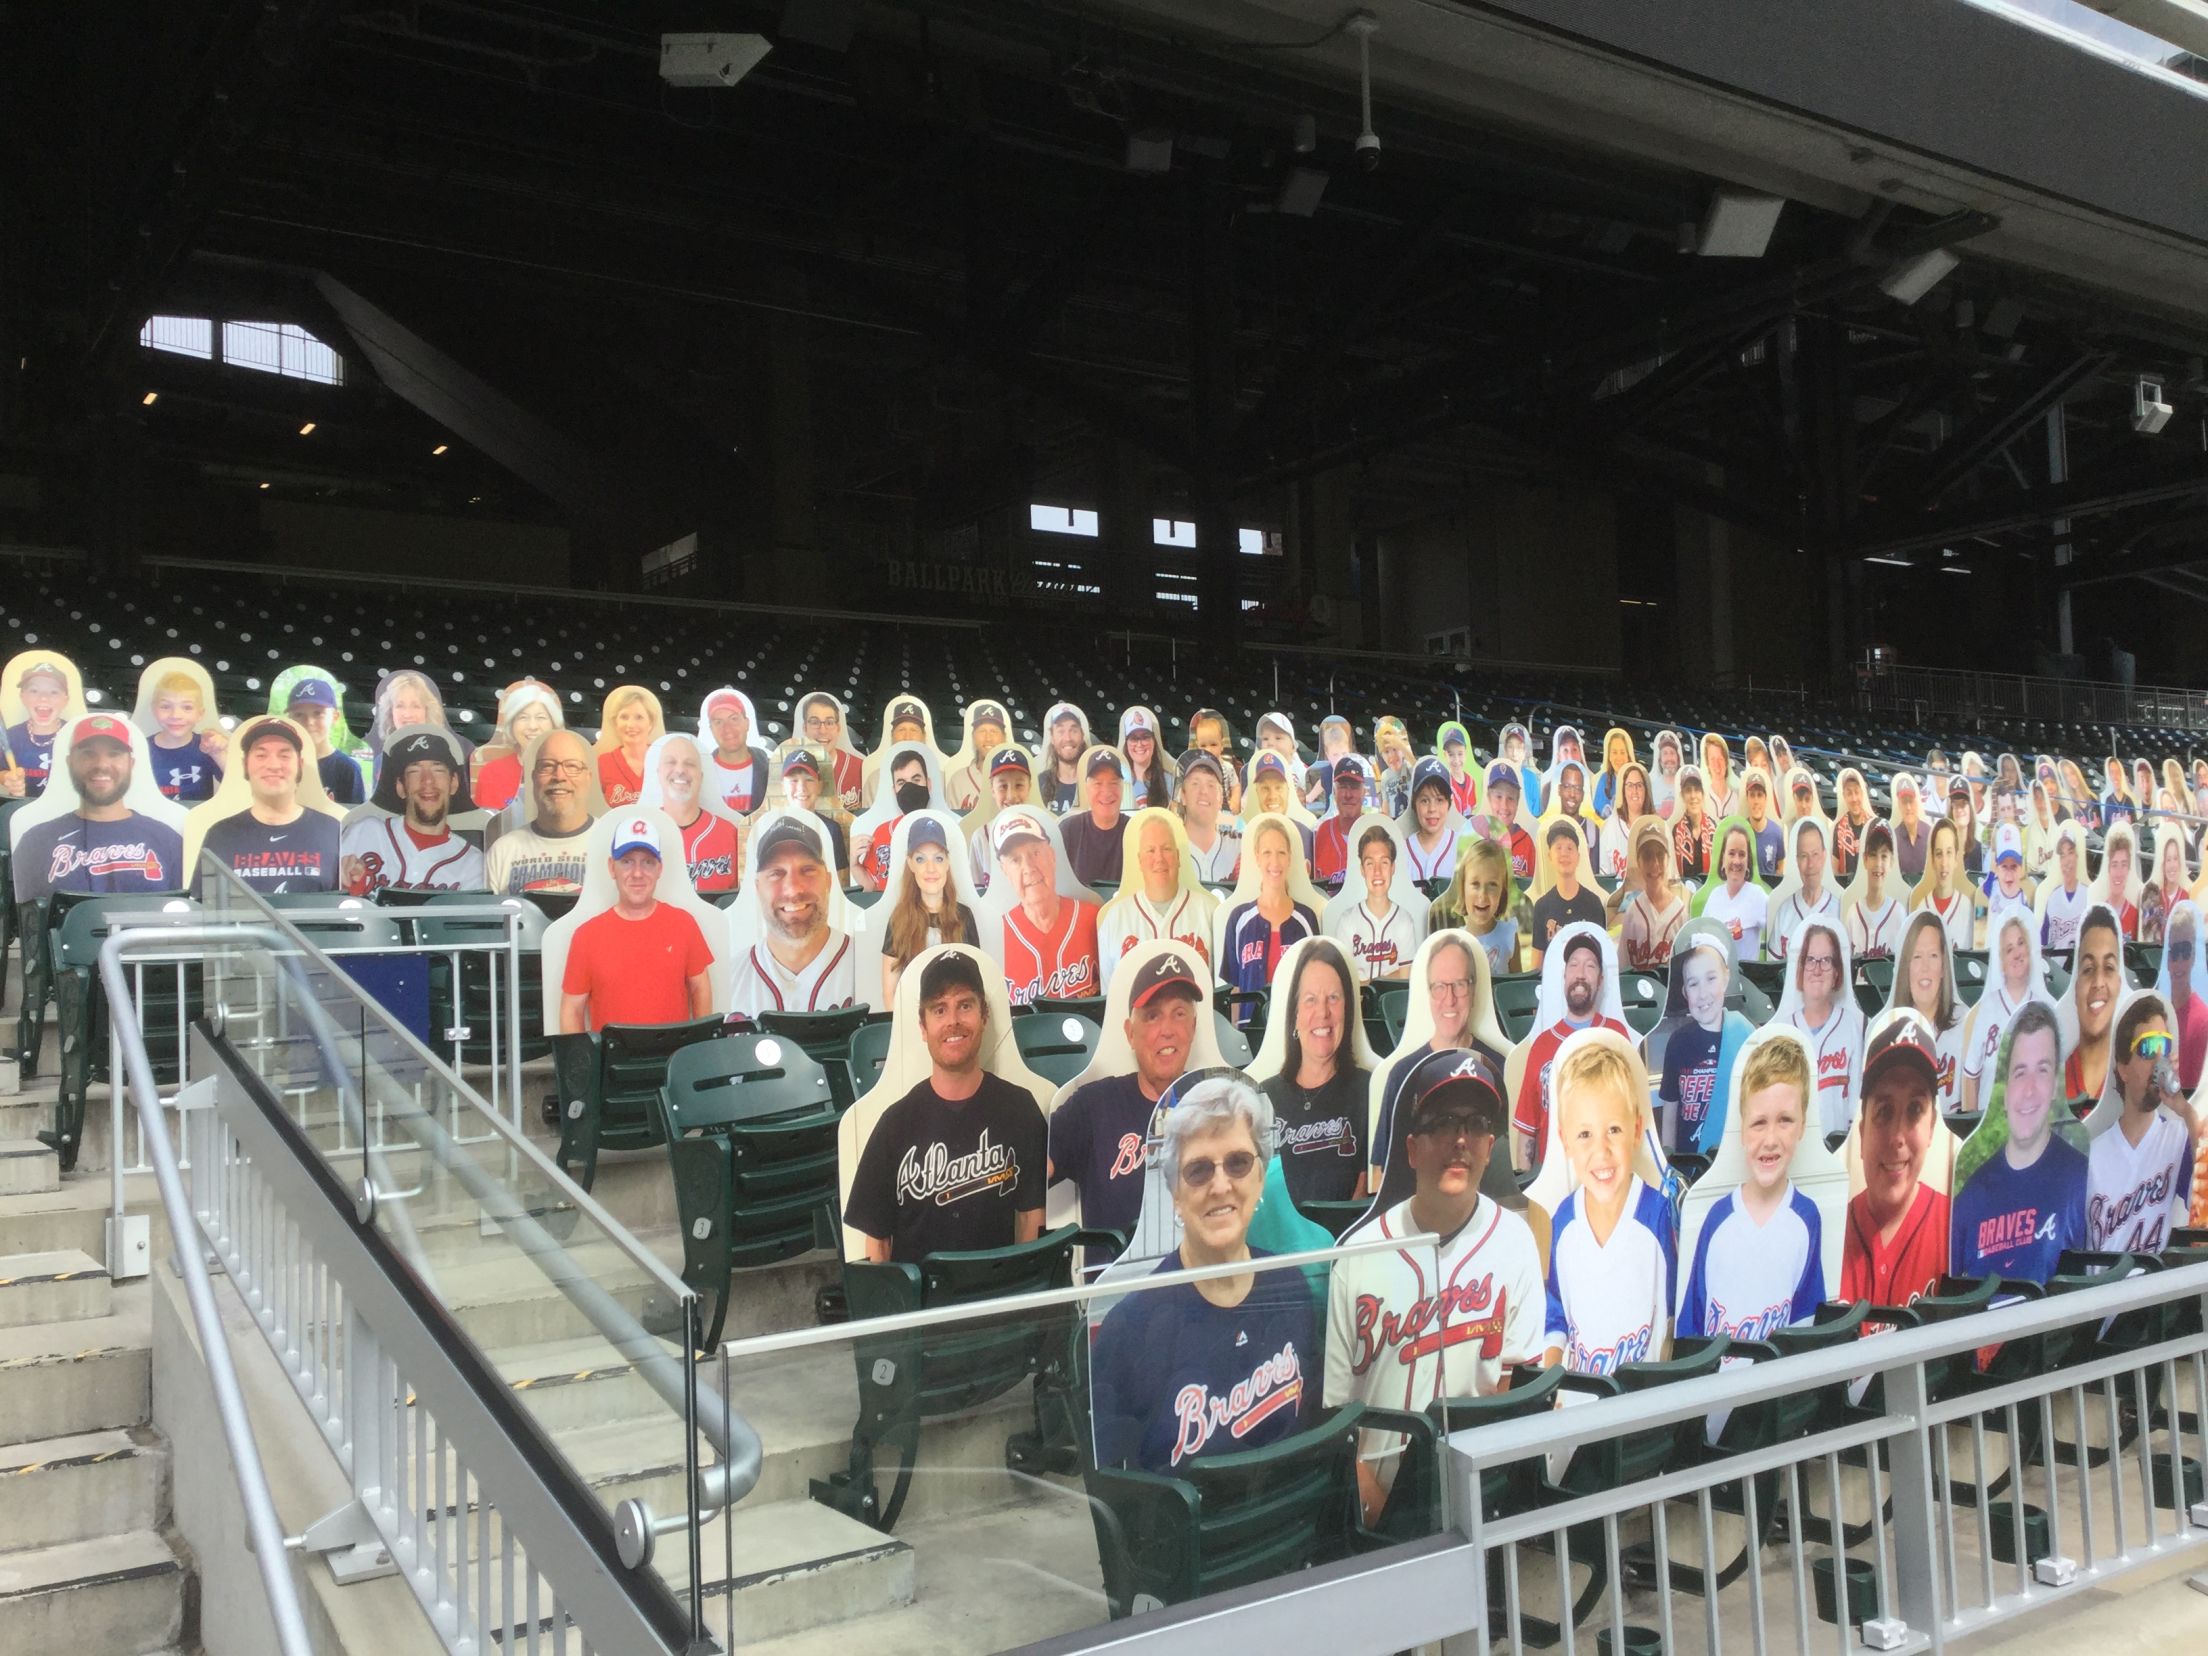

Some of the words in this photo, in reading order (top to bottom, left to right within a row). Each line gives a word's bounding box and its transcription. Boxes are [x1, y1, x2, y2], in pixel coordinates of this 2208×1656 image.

[888, 559, 1007, 595] BALLPARK
[48, 842, 146, 884] Braves
[233, 851, 321, 867] BRAVES
[233, 866, 302, 877] BASEBALL
[1155, 955, 1181, 976] A
[1449, 1056, 1478, 1078] A
[1679, 1074, 1717, 1103] DEFE
[896, 1127, 1006, 1206] Atlanta
[2088, 1162, 2175, 1252] Braves
[1977, 1207, 2038, 1250] BRAVES
[2034, 1212, 2057, 1241] A
[2126, 1213, 2167, 1253] 44
[1352, 1272, 1494, 1377] Braves
[878, 1363, 889, 1381] 2
[1170, 1341, 1296, 1467] Braves
